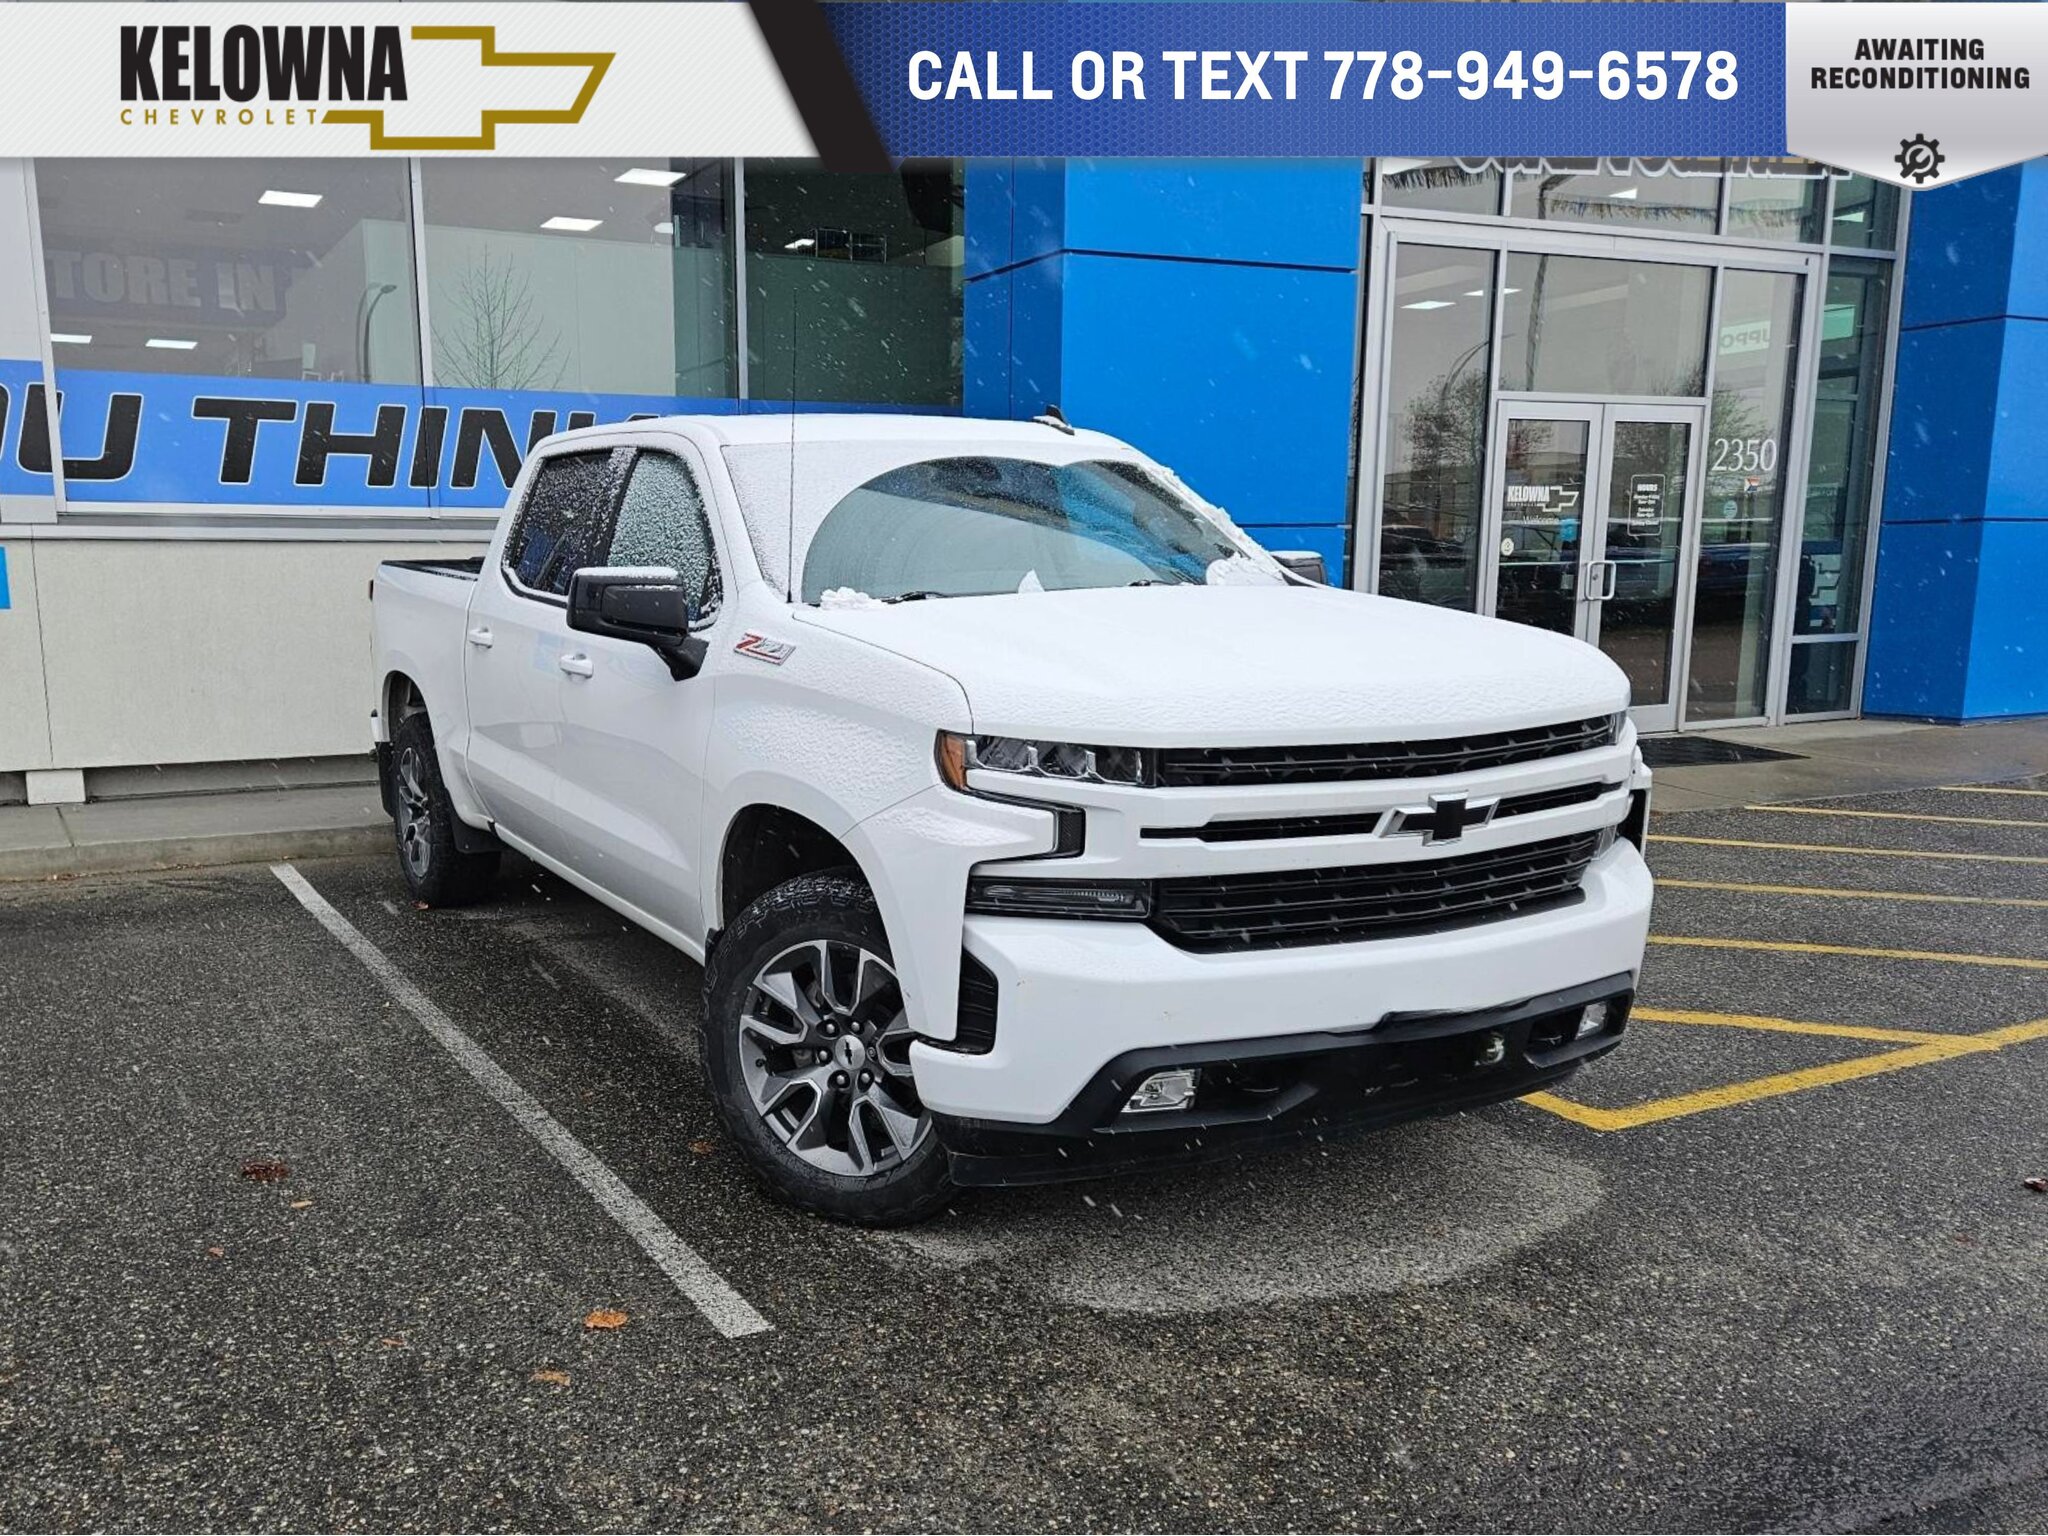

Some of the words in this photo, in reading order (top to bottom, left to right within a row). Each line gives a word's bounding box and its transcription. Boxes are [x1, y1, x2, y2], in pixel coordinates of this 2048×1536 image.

[215, 261, 278, 313] IN
[0, 381, 144, 482] U
[191, 396, 661, 490] THIN
[1711, 438, 1777, 472] 2350
[1507, 485, 1550, 503] KELOWNA
